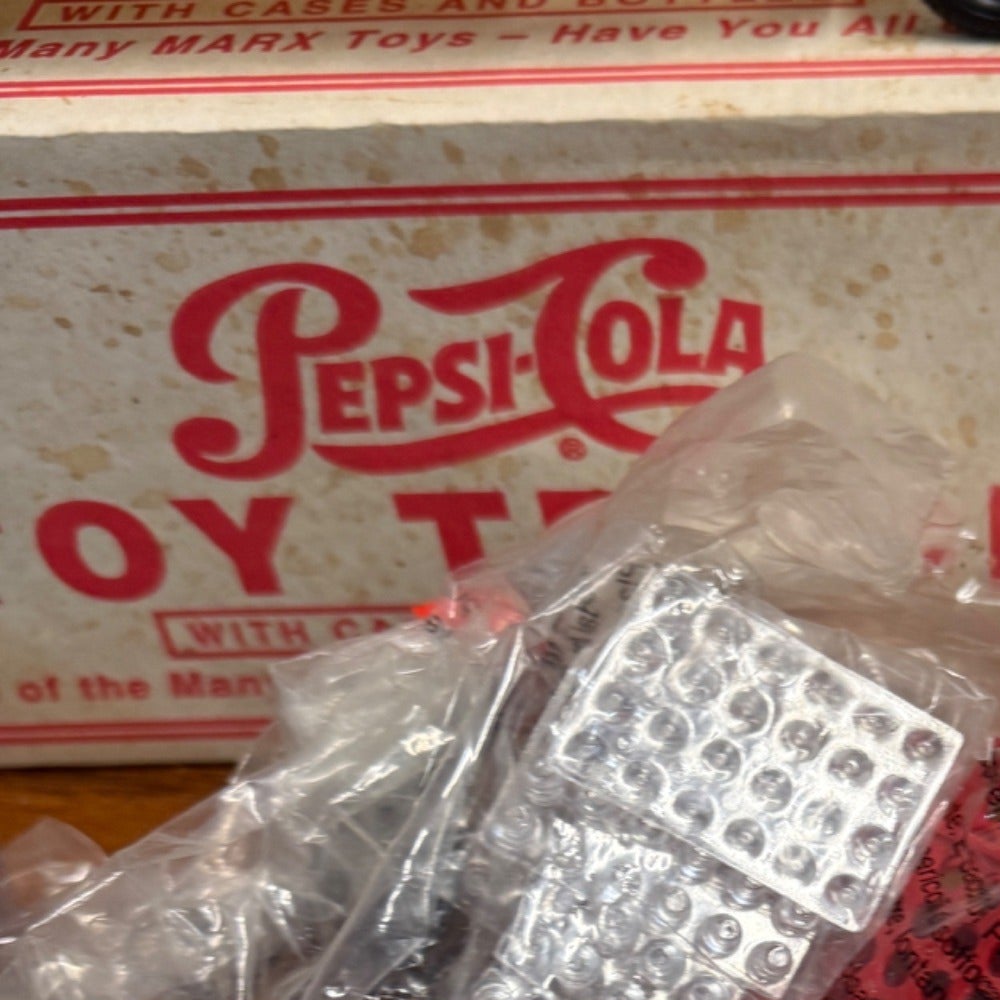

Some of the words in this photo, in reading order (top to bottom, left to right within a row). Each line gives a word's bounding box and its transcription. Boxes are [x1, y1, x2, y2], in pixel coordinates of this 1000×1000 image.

[60, 2, 194, 22] WITH
[0, 39, 136, 61] Many
[151, 31, 325, 55] MARX
[346, 29, 477, 53] Toys
[551, 23, 688, 44] Have
[717, 19, 818, 39] You
[841, 14, 920, 37] All
[35, 497, 295, 602] OY
[186, 619, 311, 647] WITH
[17, 675, 60, 702] of
[78, 674, 151, 700] the
